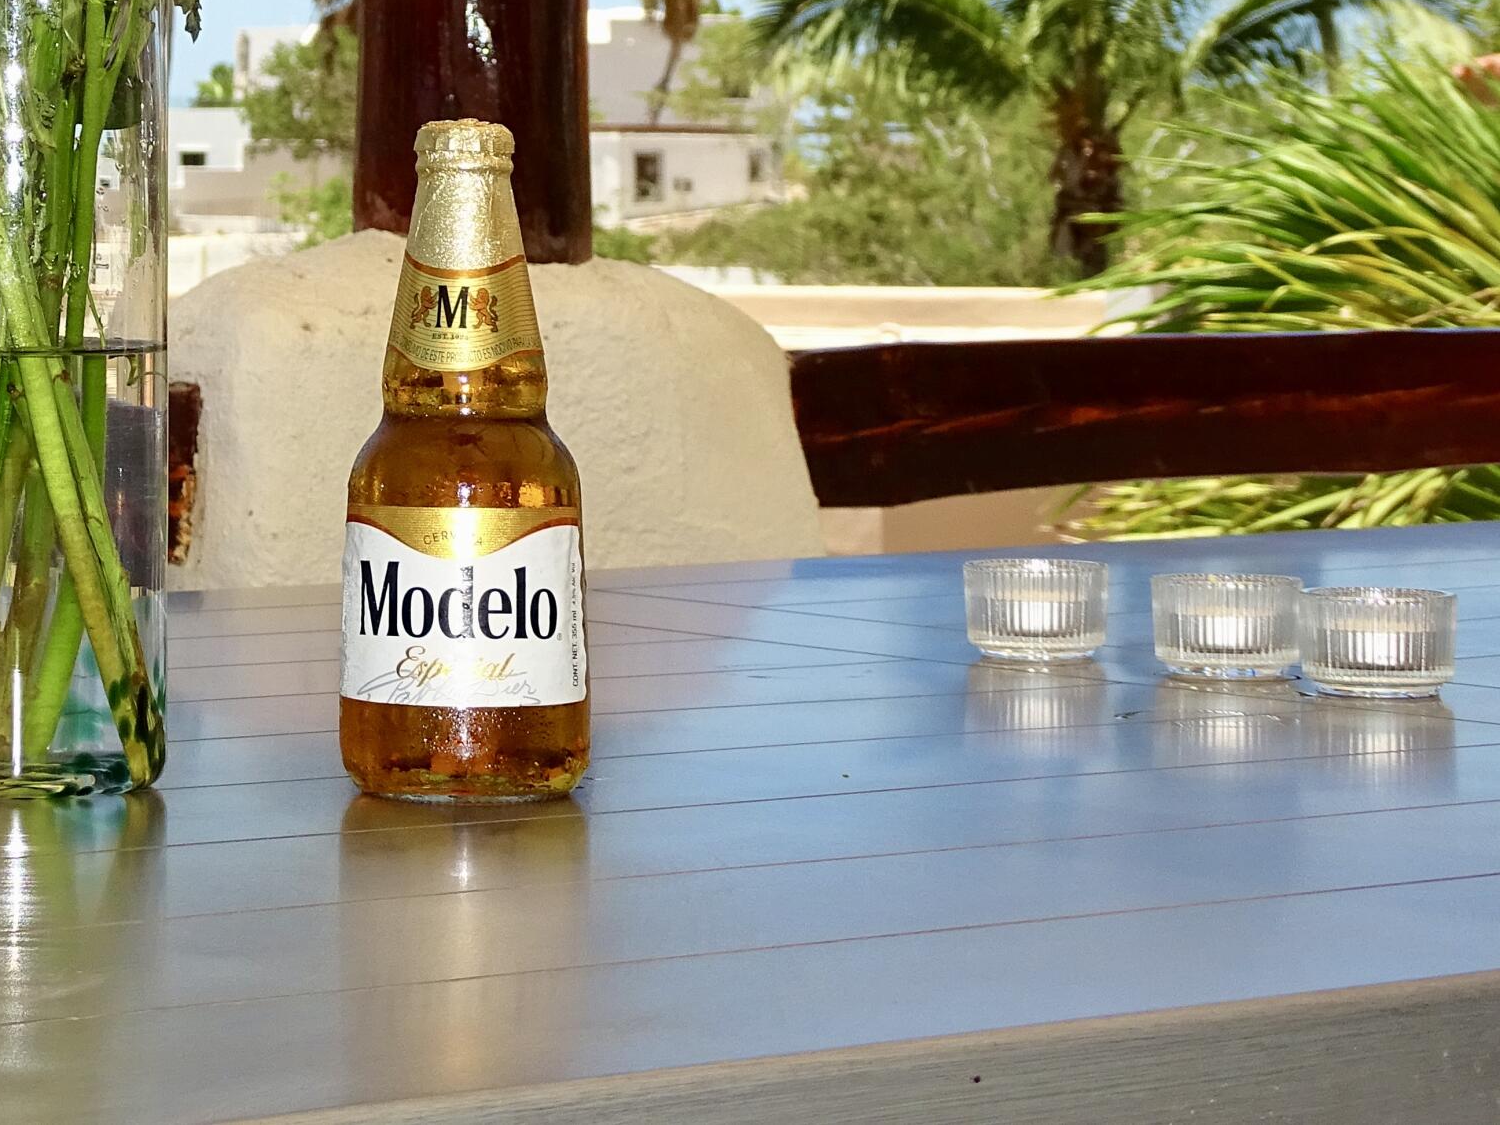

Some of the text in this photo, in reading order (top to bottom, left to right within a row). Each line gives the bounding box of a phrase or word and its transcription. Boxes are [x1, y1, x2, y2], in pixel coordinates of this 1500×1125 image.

[435, 285, 470, 329] M
[423, 530, 482, 546] CERVA
[359, 560, 558, 640] Modelo
[396, 645, 517, 688] Espal
